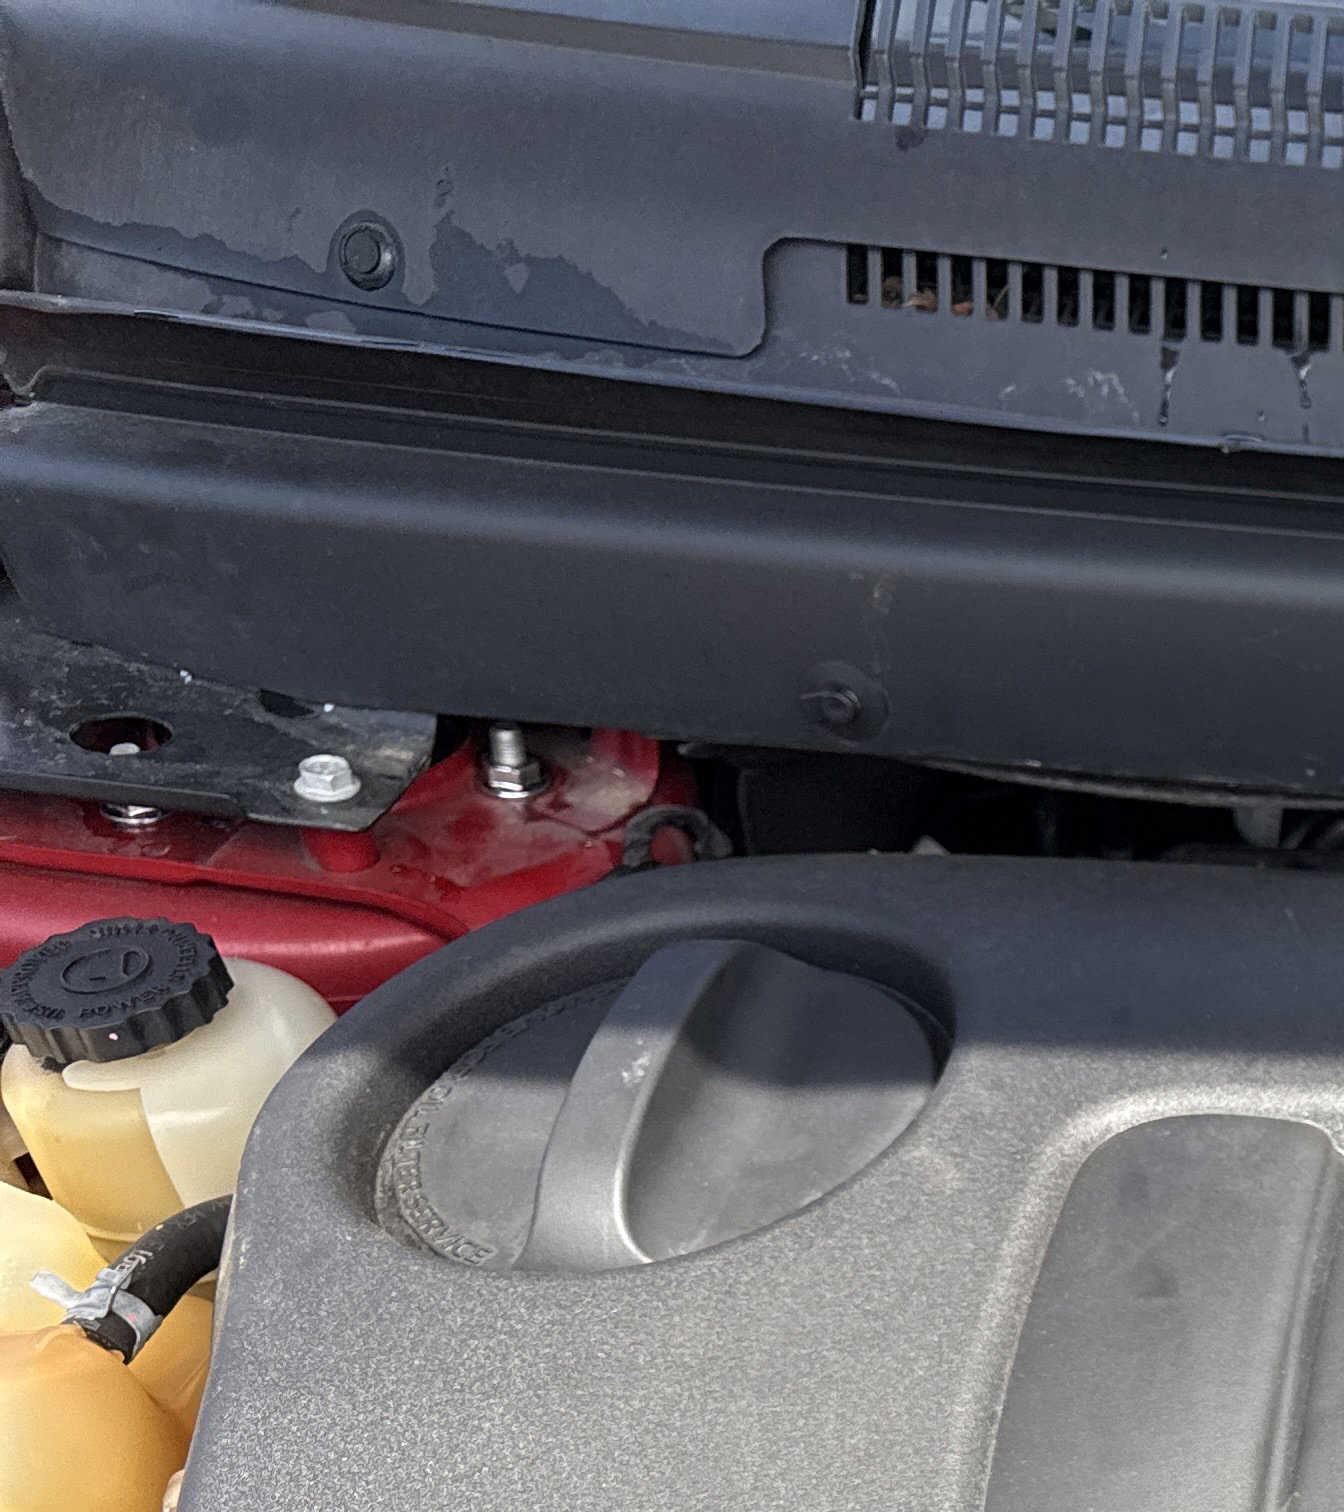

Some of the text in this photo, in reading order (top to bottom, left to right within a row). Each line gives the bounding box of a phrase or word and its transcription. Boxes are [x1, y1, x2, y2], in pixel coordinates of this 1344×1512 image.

[411, 1084, 453, 1119] OIL
[394, 1122, 431, 1196] FILTER
[401, 1190, 496, 1268] SERVICE
